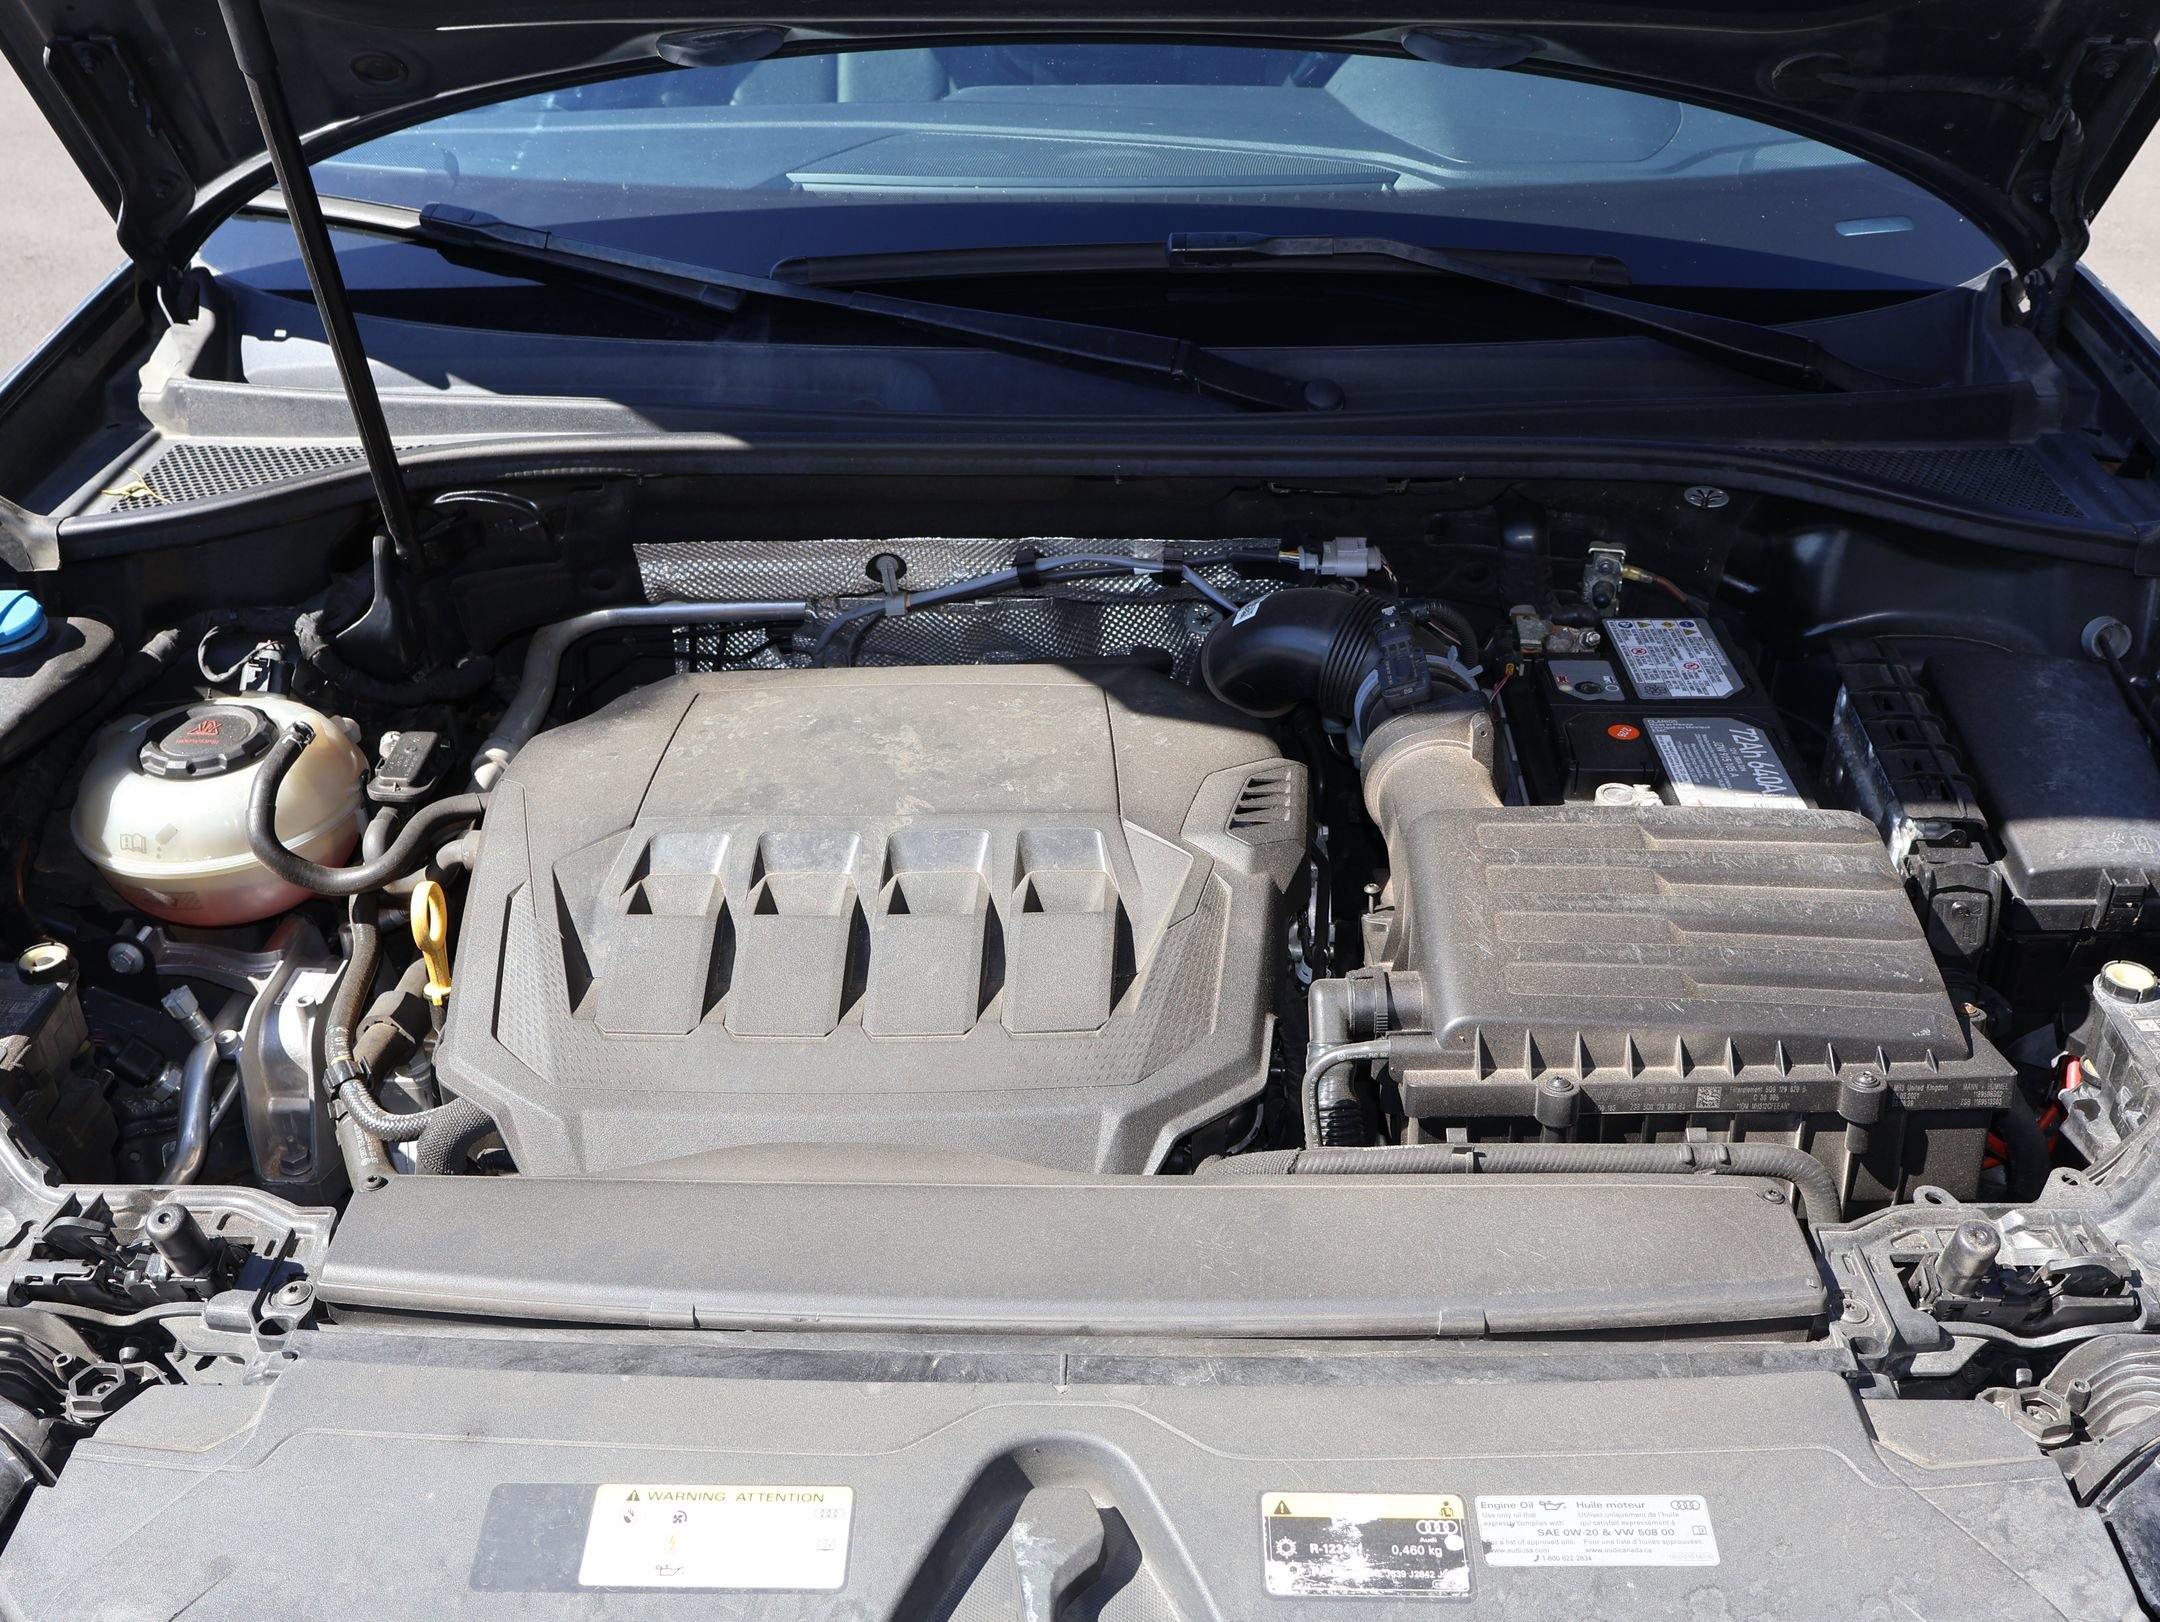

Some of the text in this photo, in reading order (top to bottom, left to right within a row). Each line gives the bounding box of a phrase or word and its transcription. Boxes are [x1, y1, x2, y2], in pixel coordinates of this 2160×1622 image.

[1729, 728, 1766, 758] 72Ah
[1747, 762, 1788, 794] 640A
[1926, 1084, 1948, 1093] Kingdom
[648, 1491, 825, 1503] WARNING ATTENTION
[1481, 1502, 1516, 1510] Engine
[1662, 1538, 1704, 1546] approuvées:
[1391, 1545, 1443, 1558] 0,460 kg
[1408, 1570, 1436, 1578] J2842
